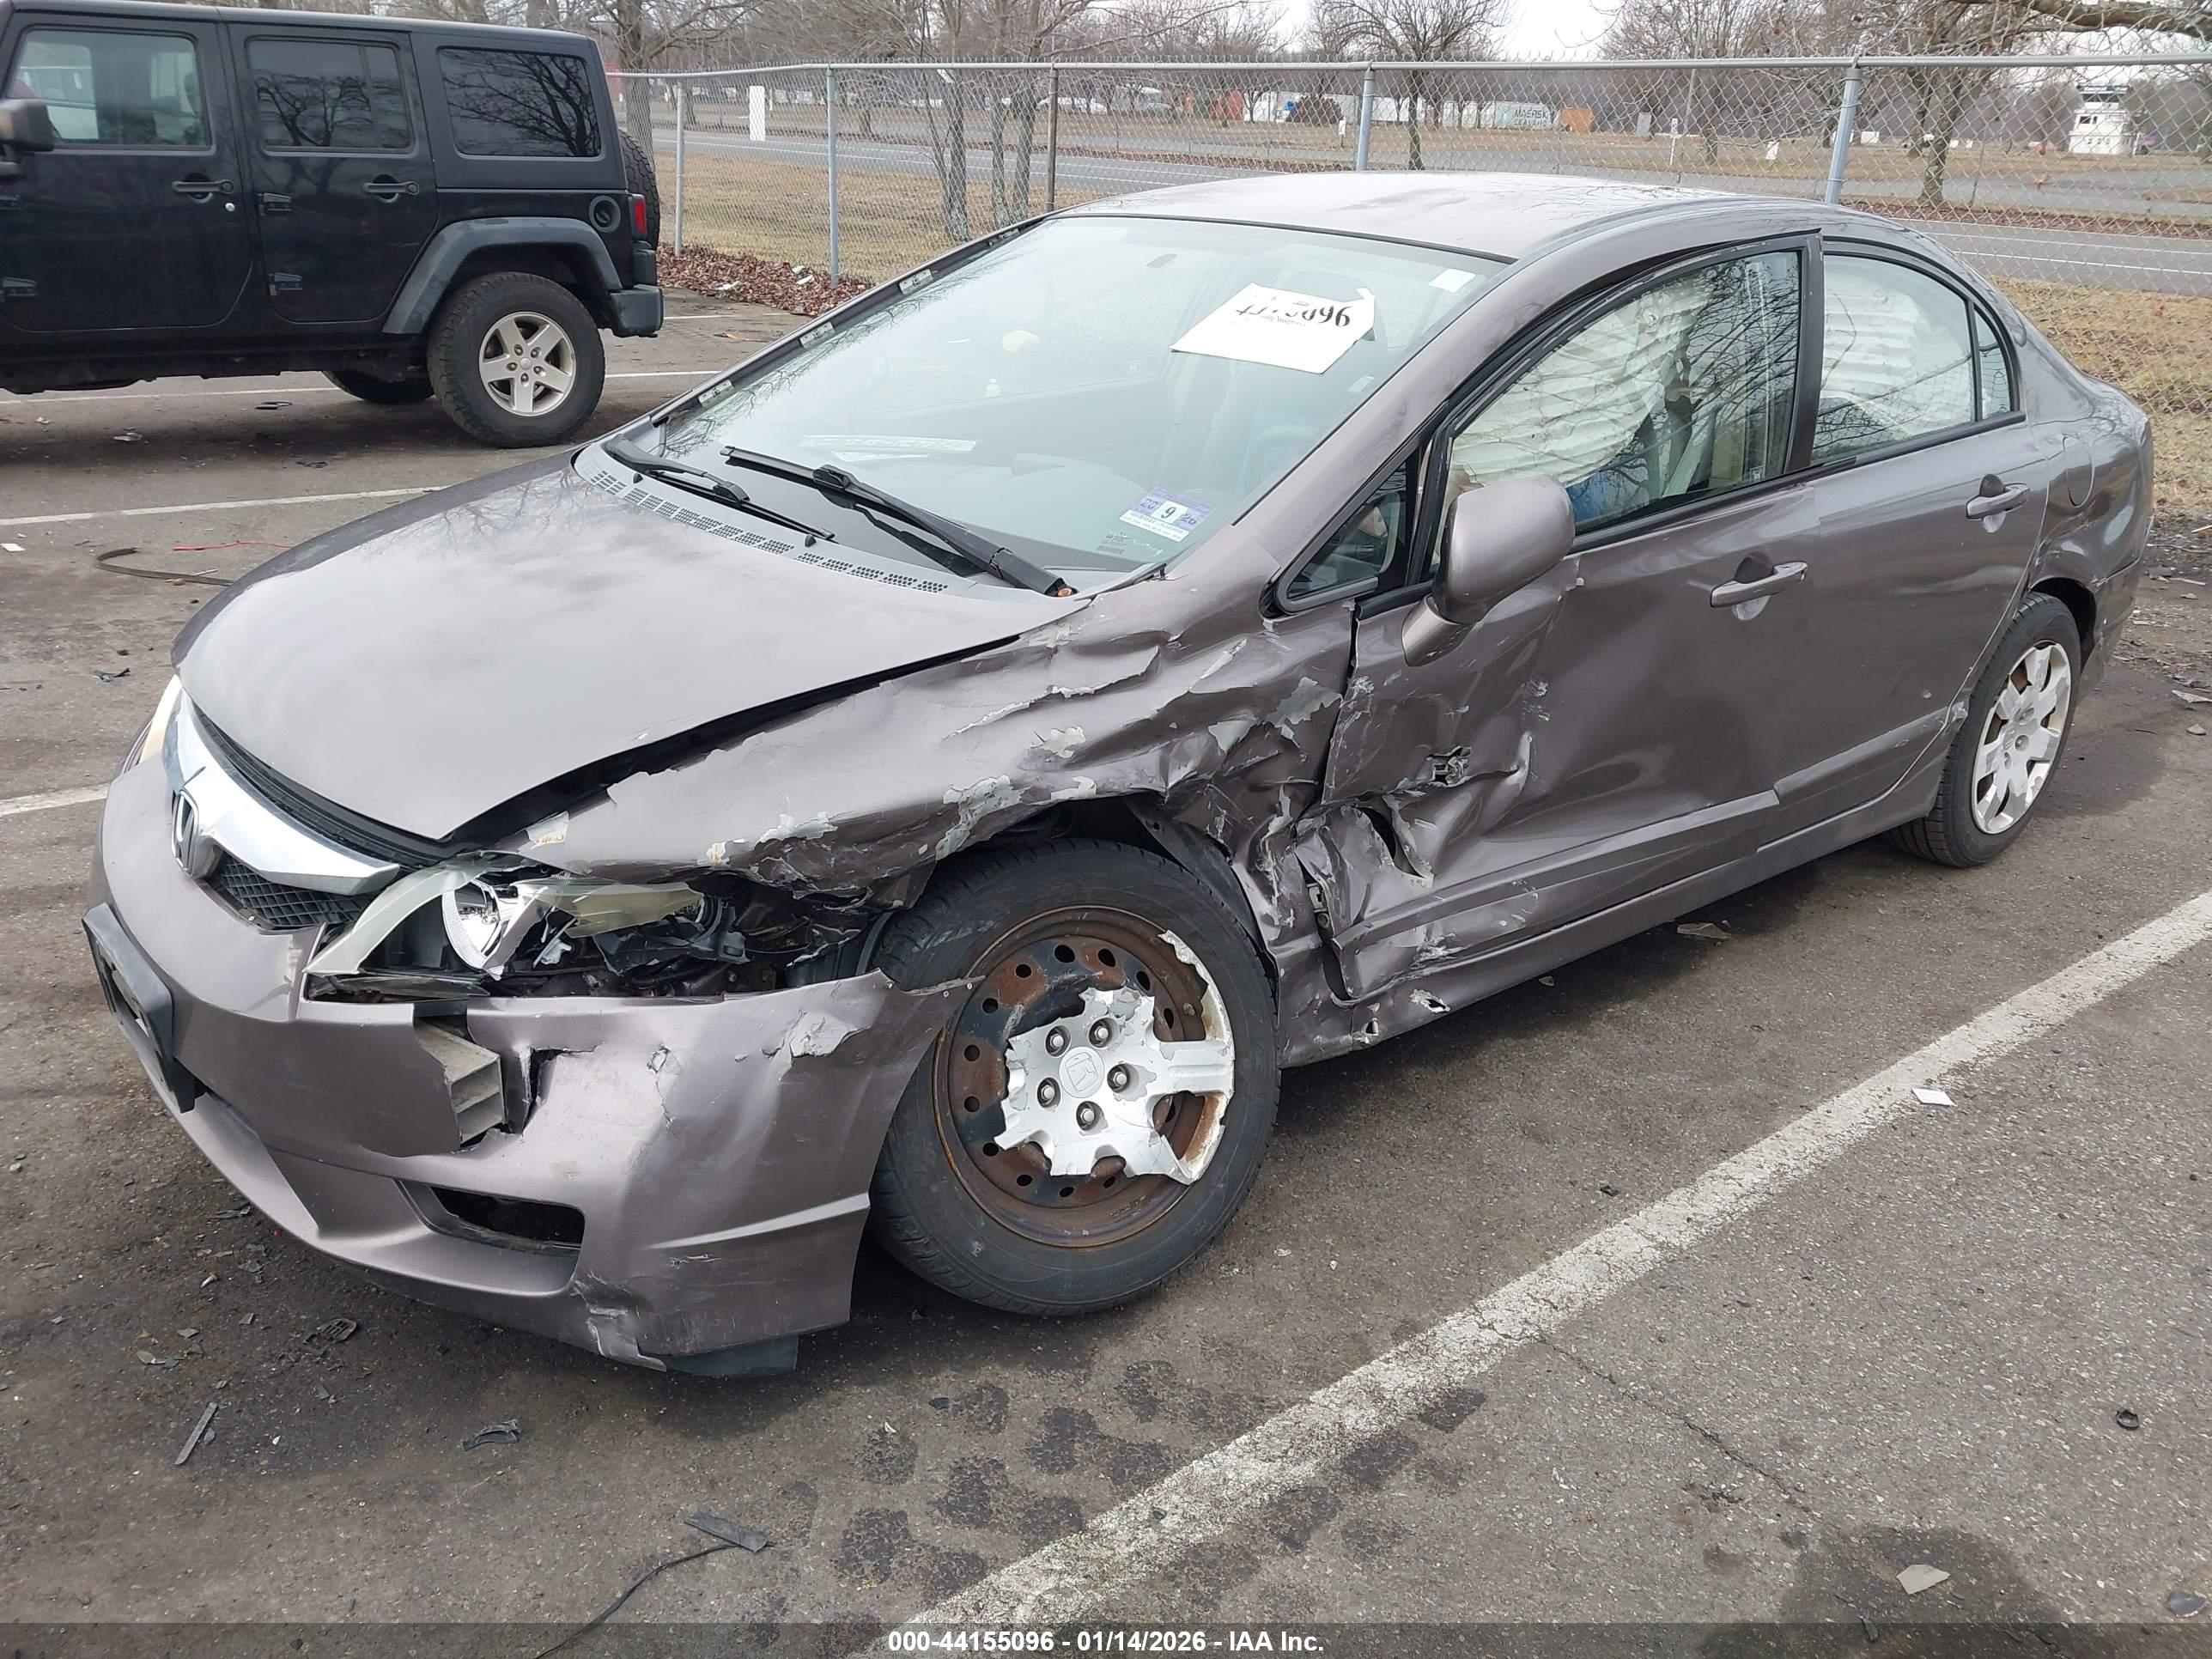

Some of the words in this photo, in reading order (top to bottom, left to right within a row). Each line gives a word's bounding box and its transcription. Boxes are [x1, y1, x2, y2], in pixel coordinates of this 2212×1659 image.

[1514, 108, 1548, 119] MAERSK
[1139, 498, 1159, 509] 20
[1160, 506, 1177, 520] 9
